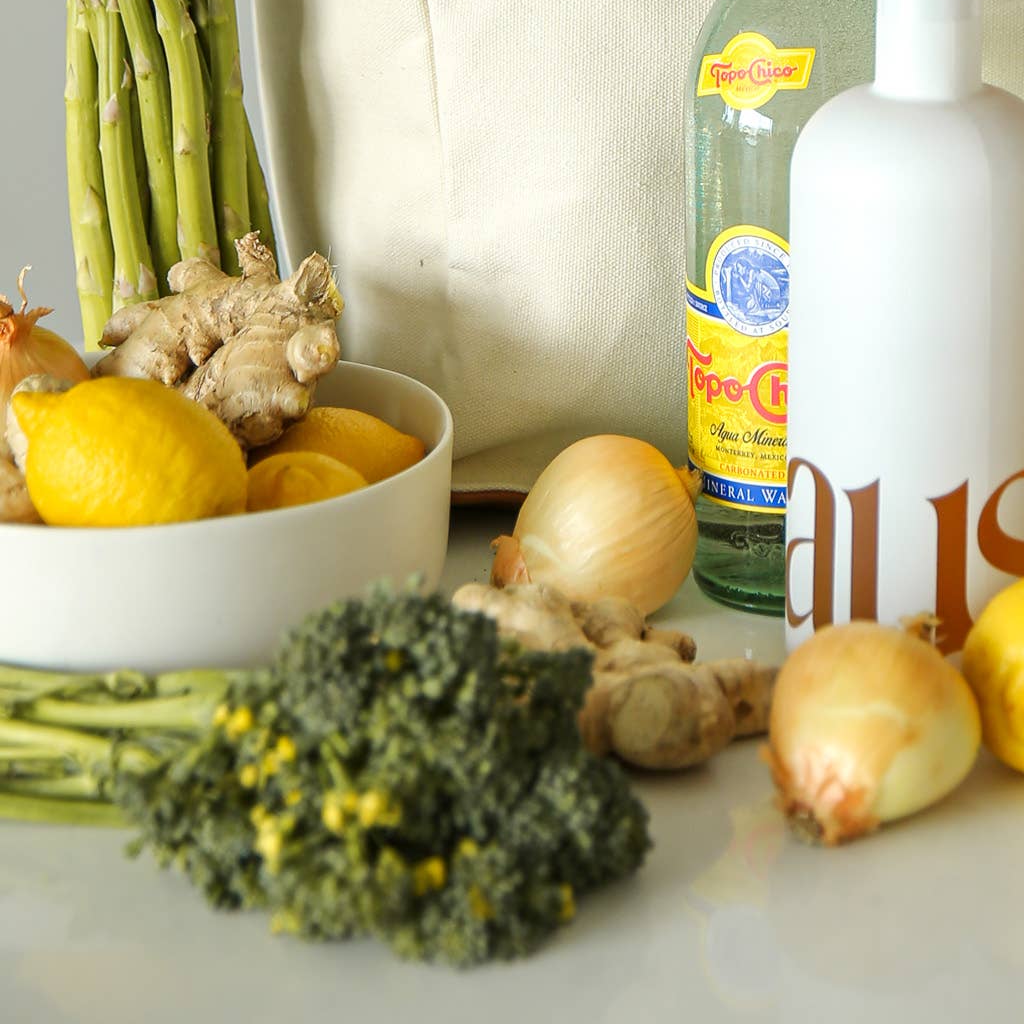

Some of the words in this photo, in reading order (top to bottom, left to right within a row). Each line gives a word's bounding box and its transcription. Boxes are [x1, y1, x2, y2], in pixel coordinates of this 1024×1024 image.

[711, 62, 750, 88] Topo
[749, 58, 799, 86] Chico
[709, 421, 740, 446] Agua
[719, 462, 786, 480] CARBONATED
